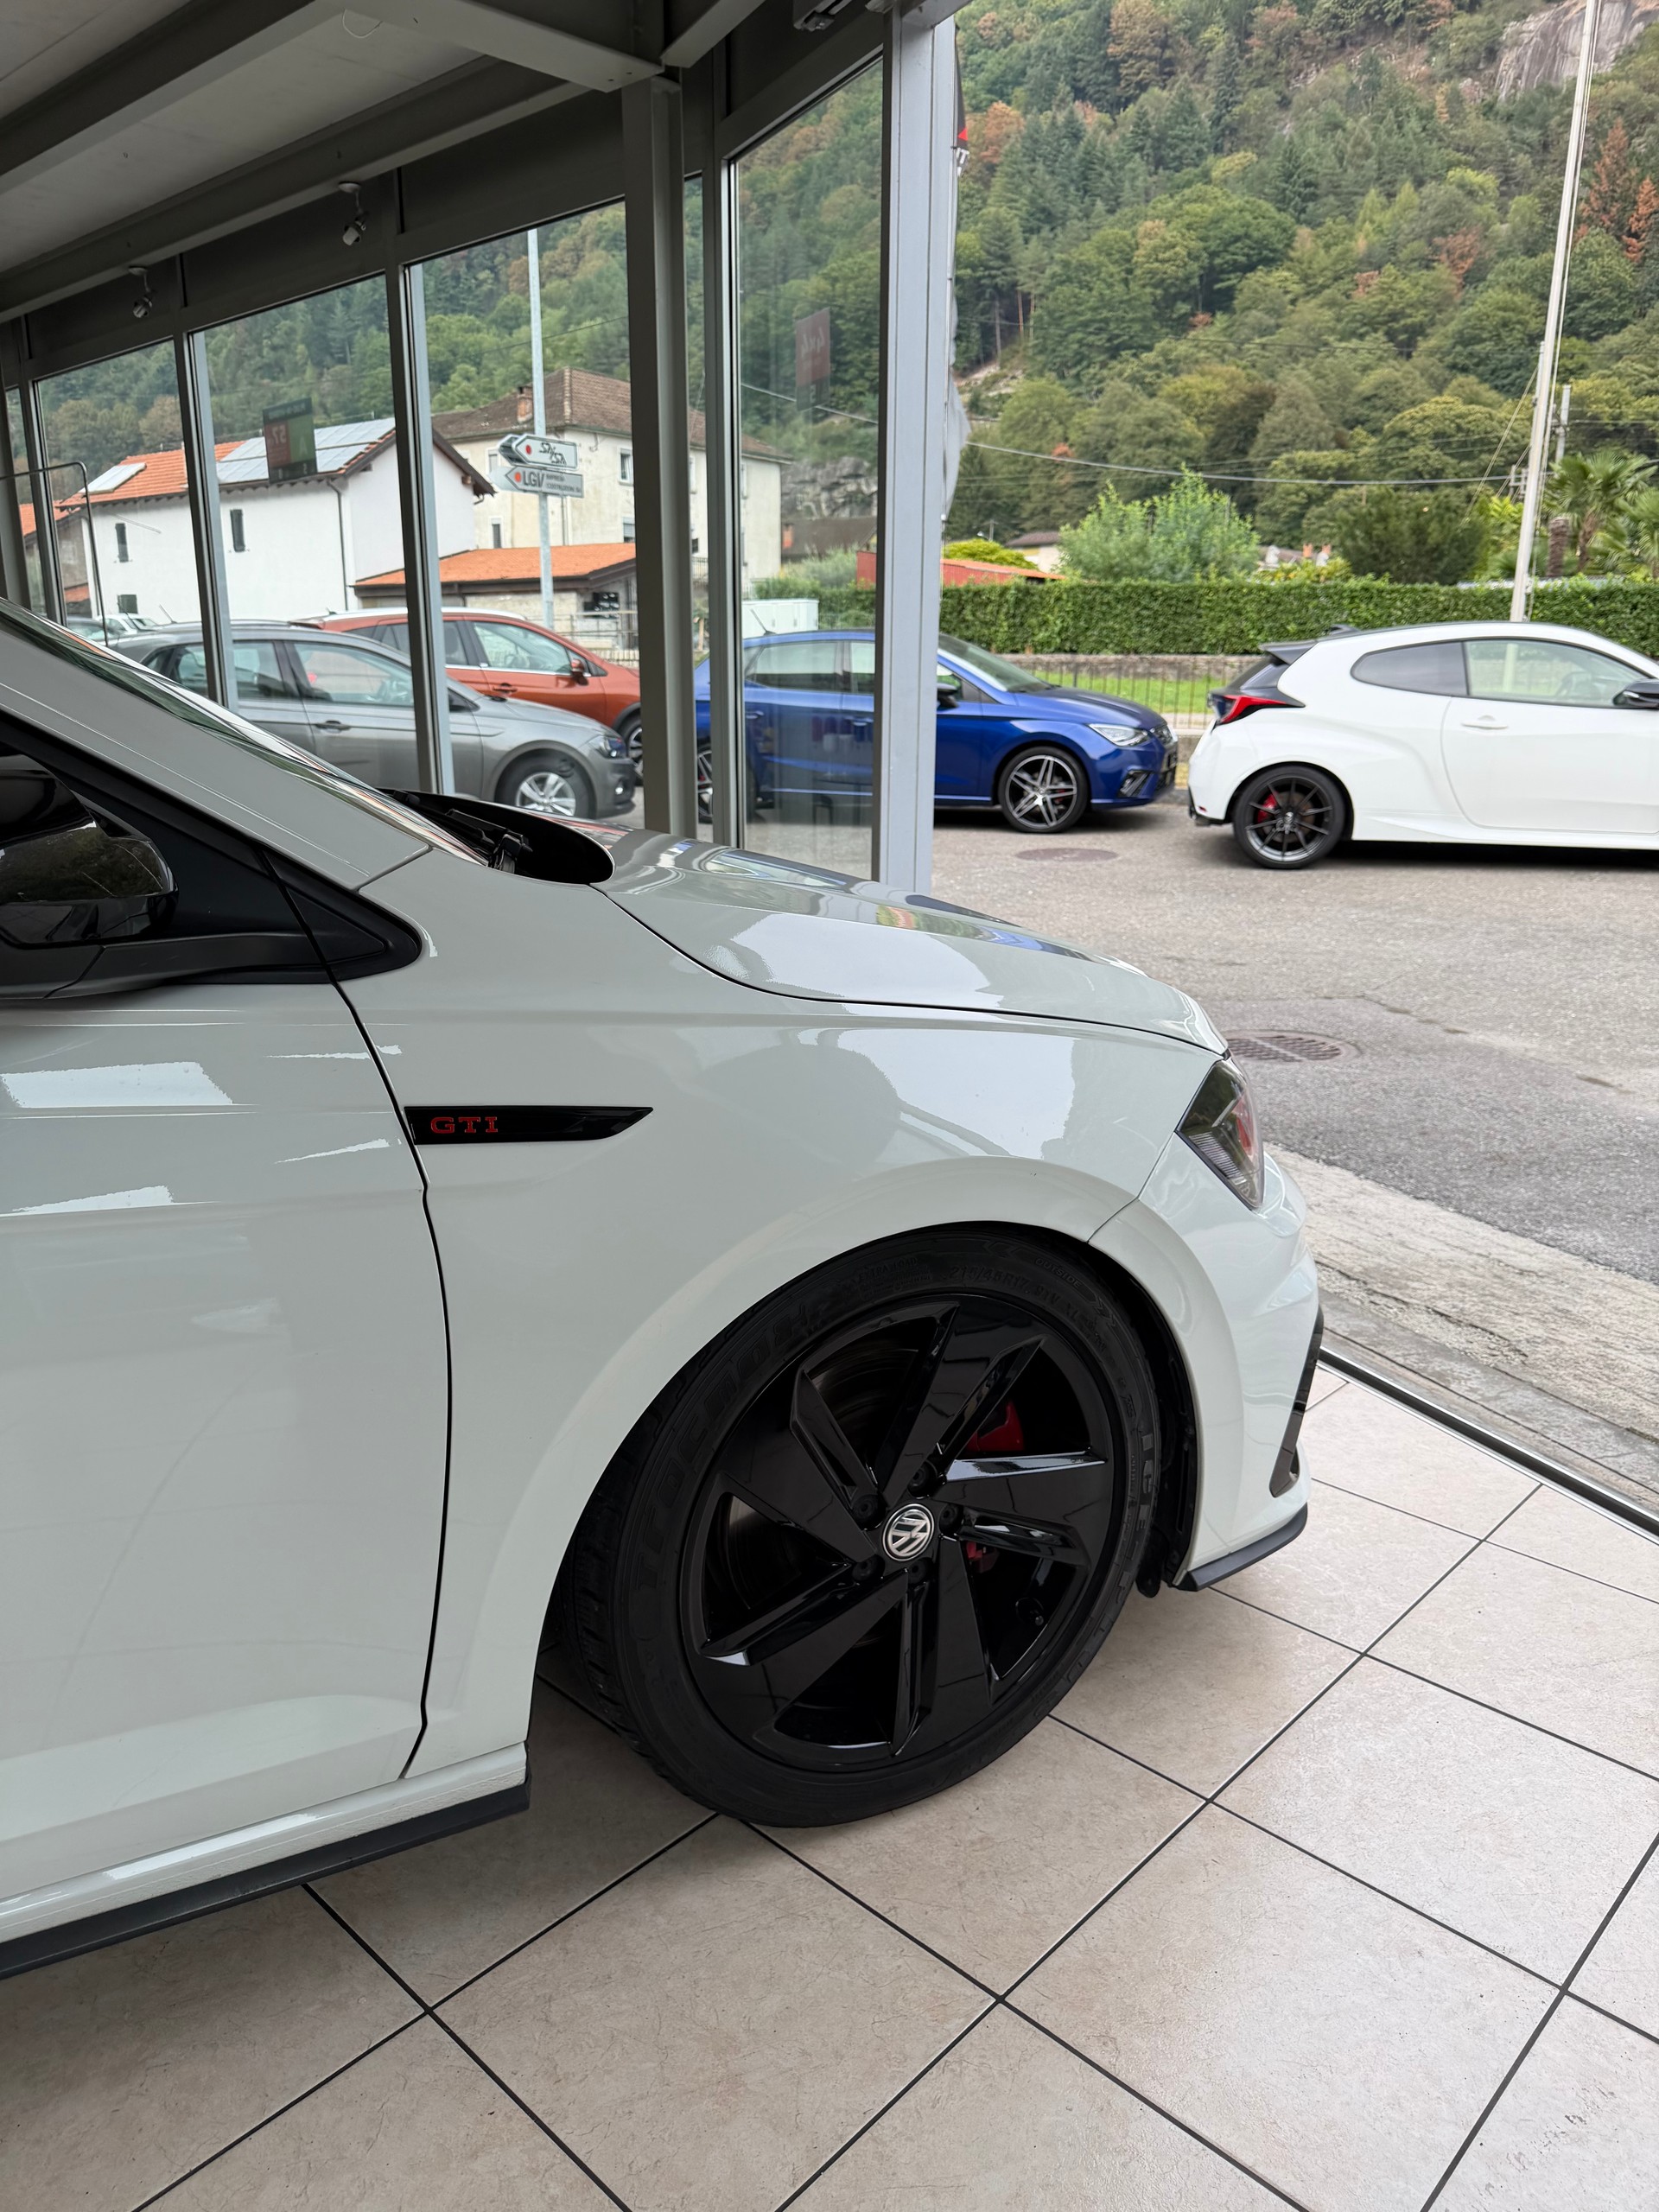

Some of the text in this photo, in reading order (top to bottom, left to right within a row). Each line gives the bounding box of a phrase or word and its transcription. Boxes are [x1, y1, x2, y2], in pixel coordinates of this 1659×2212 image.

[523, 470, 544, 487] LGV
[430, 1116, 499, 1134] GTI
[1034, 1256, 1084, 1290] OUTSIDE
[886, 1506, 933, 1559] VW
